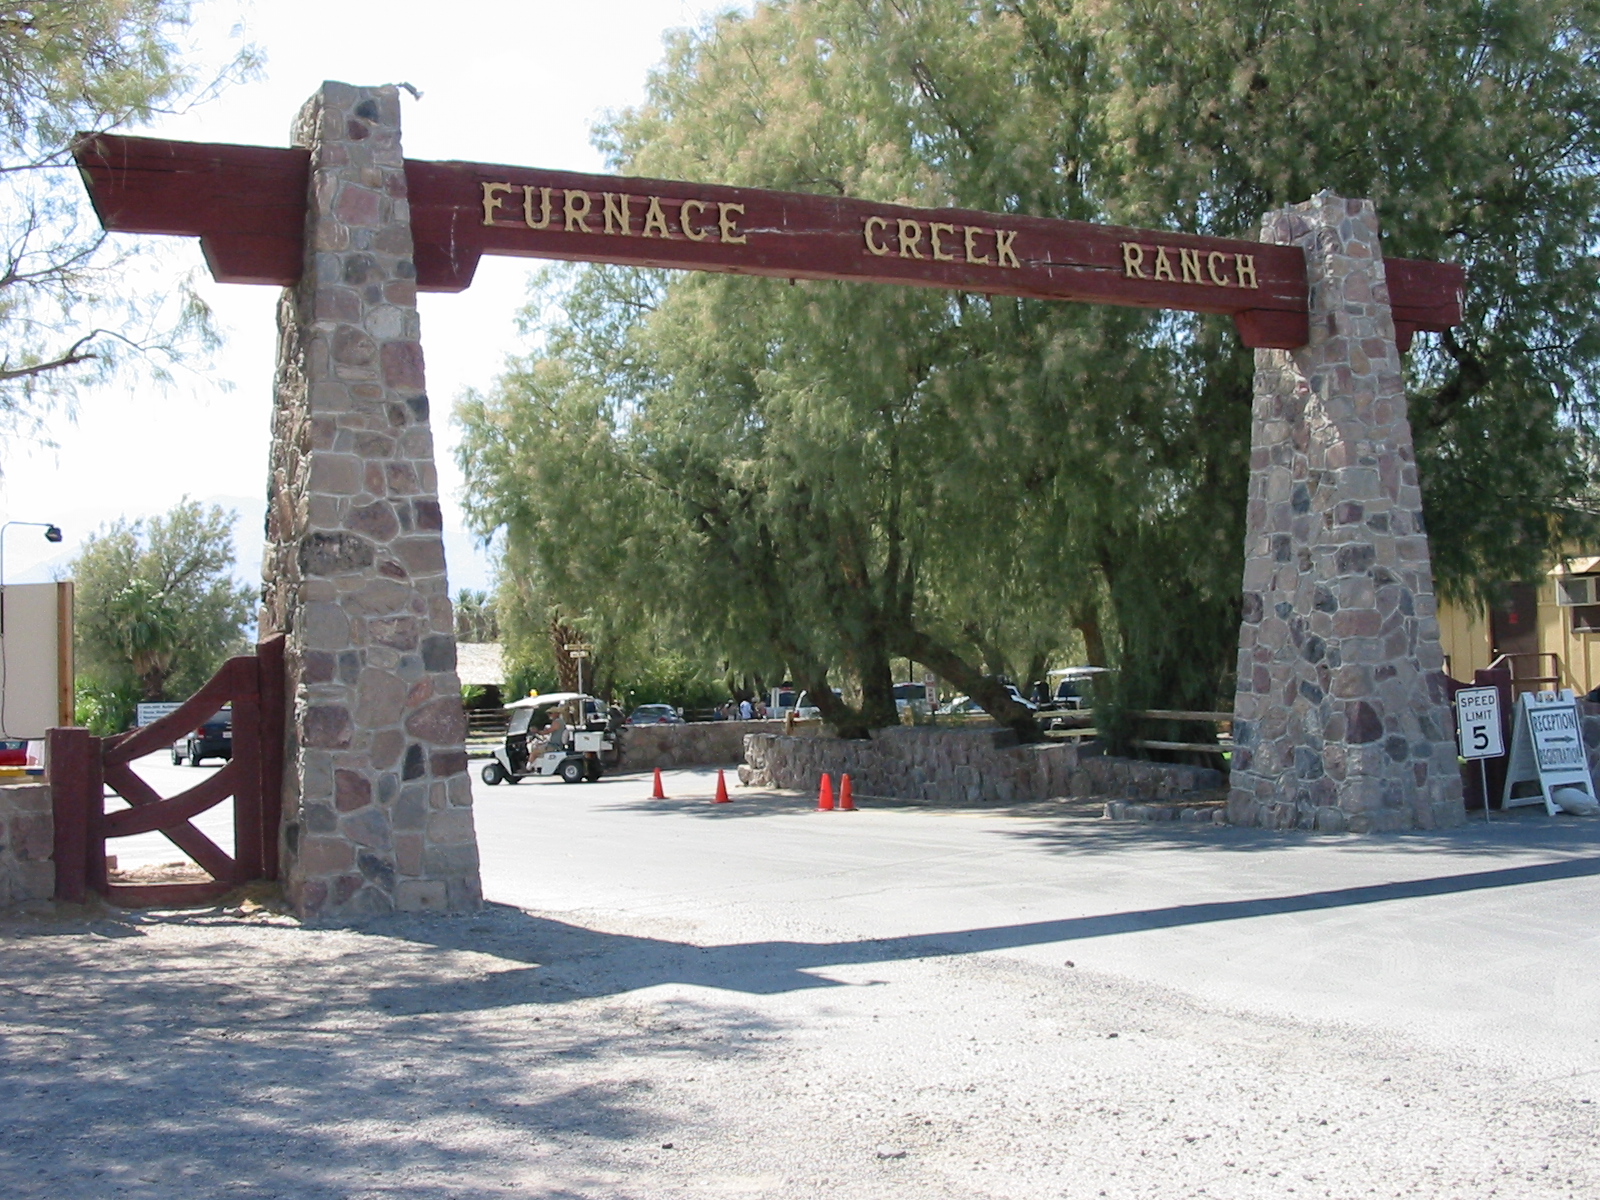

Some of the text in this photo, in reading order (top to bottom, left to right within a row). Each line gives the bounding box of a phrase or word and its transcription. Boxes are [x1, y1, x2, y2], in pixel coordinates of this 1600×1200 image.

[481, 181, 1259, 289] FURNACE CREEK RANCH
[1461, 695, 1495, 707] SPEED
[1465, 710, 1492, 721] LIMIT
[1533, 712, 1576, 732] RECEPTION
[1473, 725, 1489, 750] 5
